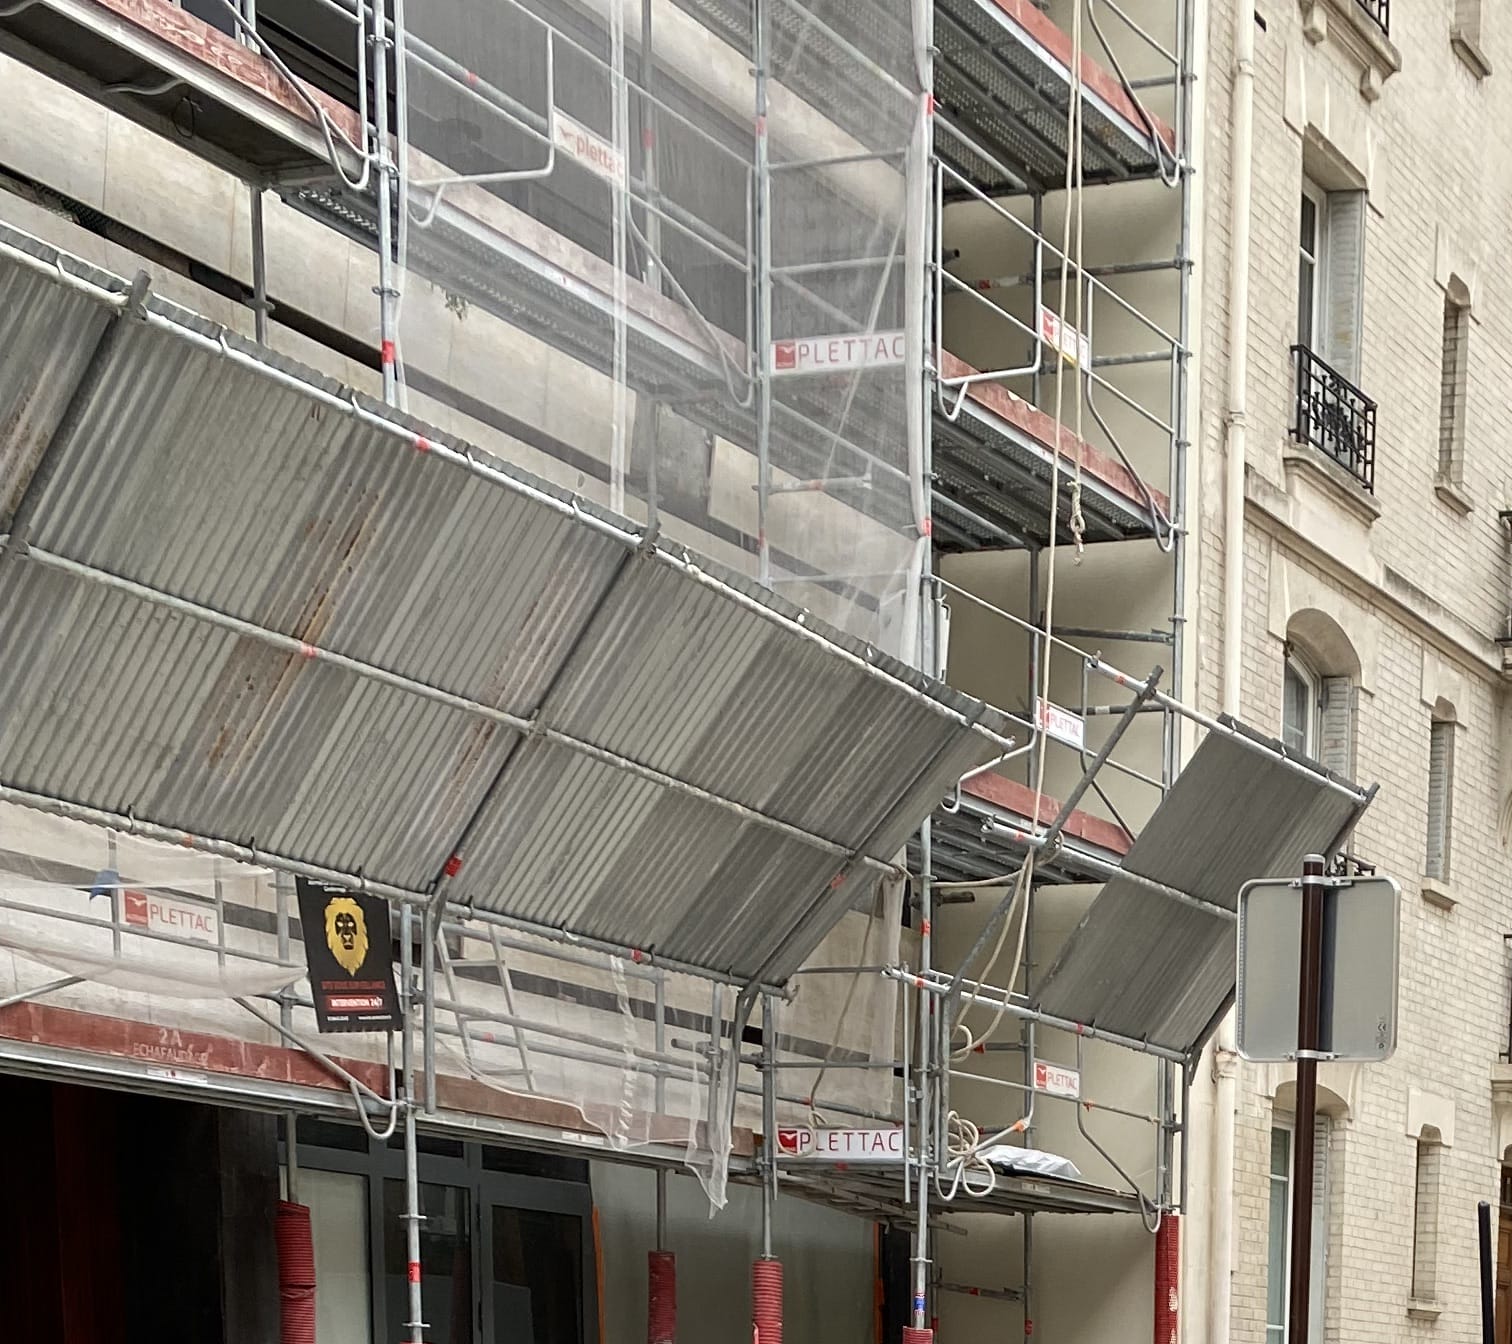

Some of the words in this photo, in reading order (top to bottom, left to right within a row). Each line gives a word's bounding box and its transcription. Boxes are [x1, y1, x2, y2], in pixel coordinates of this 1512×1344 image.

[798, 335, 905, 364] PLETTAC
[150, 902, 213, 933] PLETTAC
[799, 1131, 900, 1152] PLETTAC
